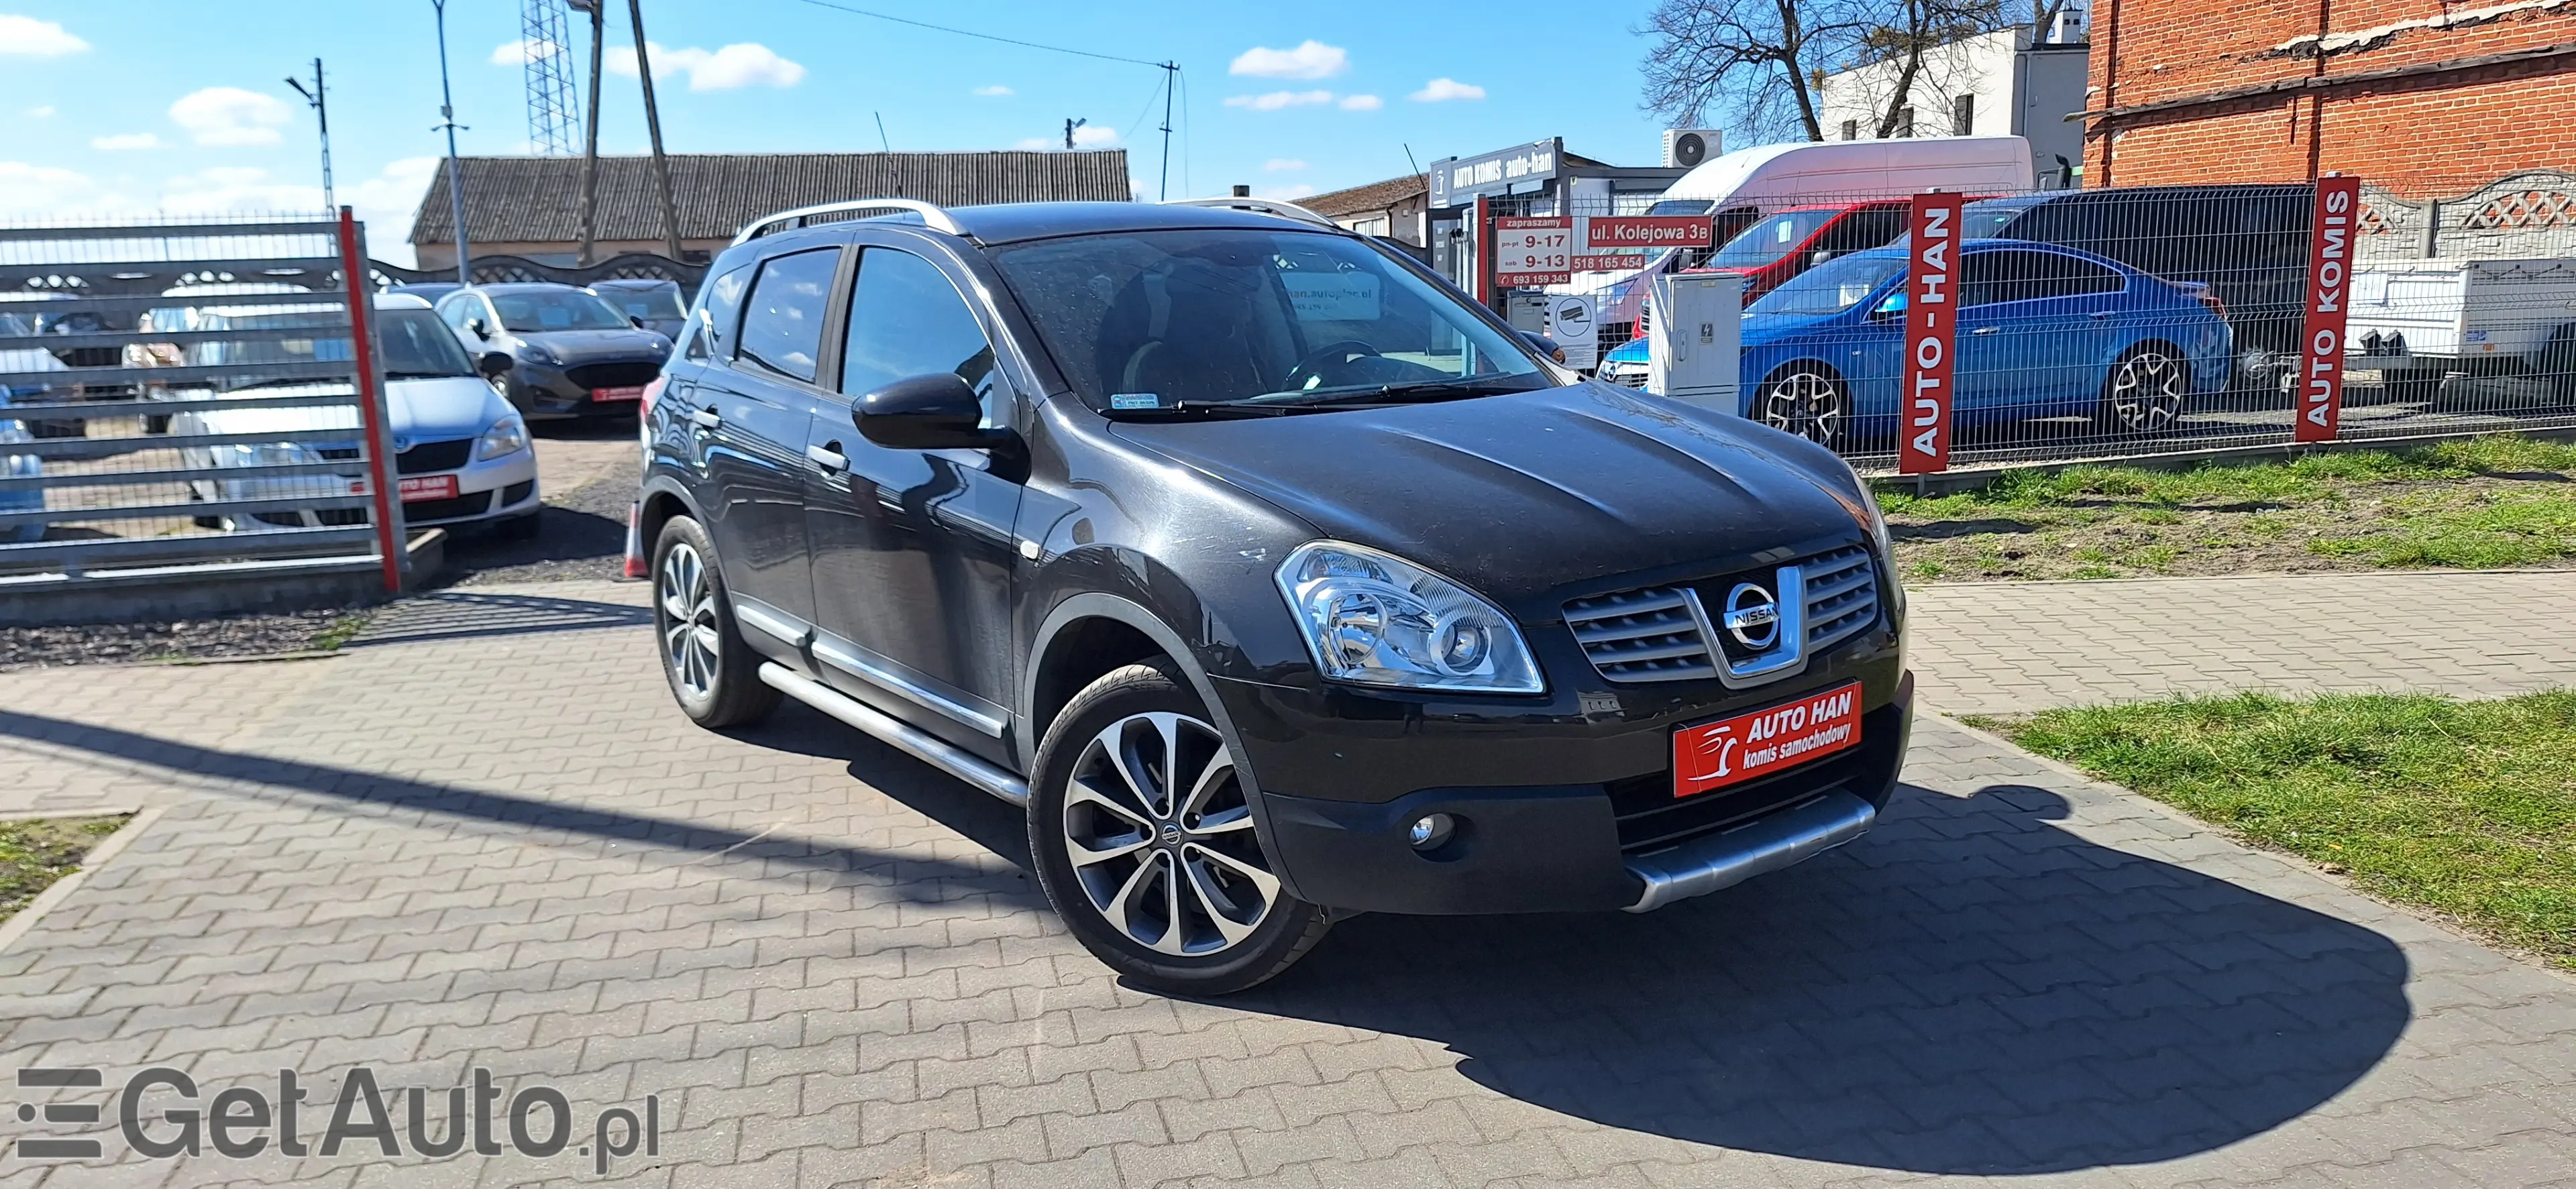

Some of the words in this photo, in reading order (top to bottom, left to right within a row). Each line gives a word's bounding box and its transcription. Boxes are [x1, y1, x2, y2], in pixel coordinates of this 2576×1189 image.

[1453, 165, 1473, 189] AUTO
[1474, 159, 1502, 185] KOMIS
[1506, 152, 1552, 178] auto-han
[1506, 219, 1561, 228] zapraszamy
[1591, 225, 1610, 241] ul.
[1614, 224, 1685, 243] Kolejowa
[1689, 223, 1708, 240] 3B
[1525, 235, 1565, 248] 9-17
[2316, 190, 2349, 313] KOMIS
[1525, 255, 1565, 268] 9-13
[1574, 258, 1595, 269] 518
[1598, 257, 1618, 268] 165
[1621, 256, 1642, 268] 454
[1513, 275, 1530, 284] 693
[1533, 274, 1549, 284] 159
[1551, 274, 1568, 283] 343
[2306, 329, 2337, 427] AUTO
[1734, 606, 1779, 624] NISSAN
[1746, 705, 1806, 744] AUTO
[1810, 691, 1852, 726] HAN
[1743, 742, 1778, 770] komis
[1779, 722, 1851, 760] samochodowy
